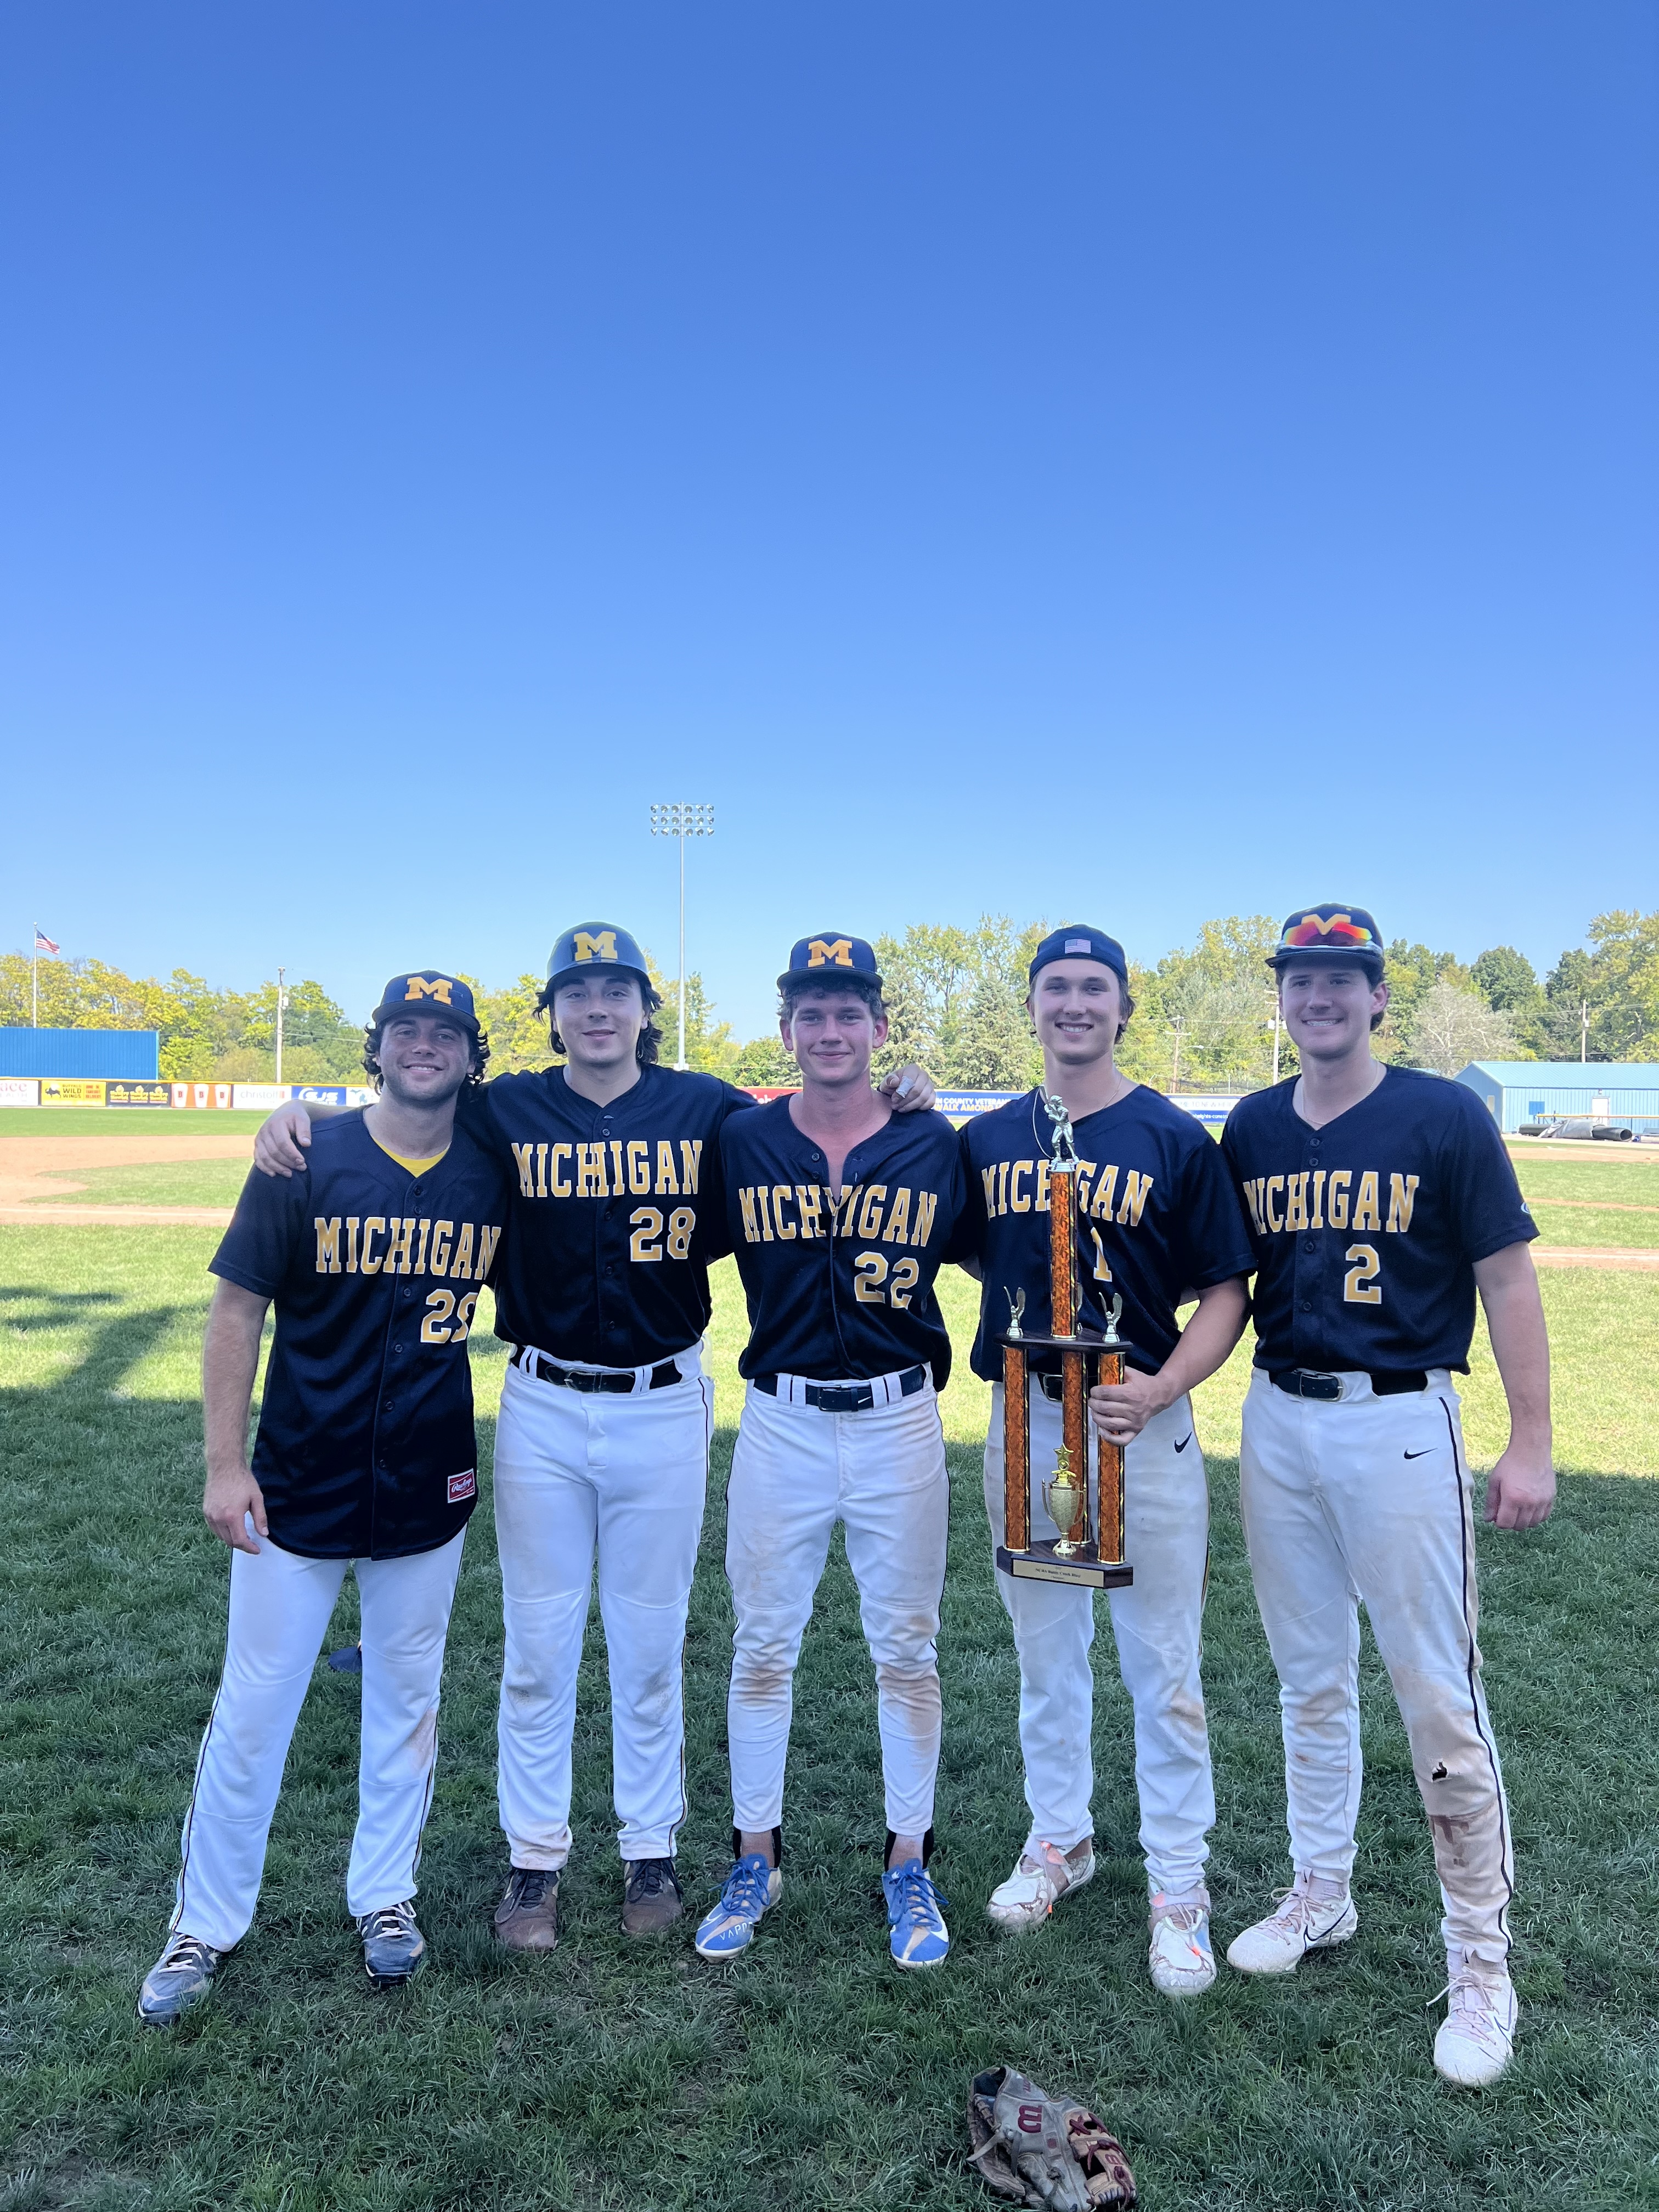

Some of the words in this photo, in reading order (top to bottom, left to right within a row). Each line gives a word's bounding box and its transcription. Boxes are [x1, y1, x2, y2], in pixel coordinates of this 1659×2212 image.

[574, 931, 618, 962] M
[808, 939, 853, 968] M
[405, 977, 453, 1005] M
[511, 1140, 703, 1197] MICHIGAN
[314, 1216, 501, 1280] MICHIGAN
[629, 1207, 696, 1261] 28
[854, 1251, 919, 1310] 22
[1344, 1243, 1382, 1305] 2
